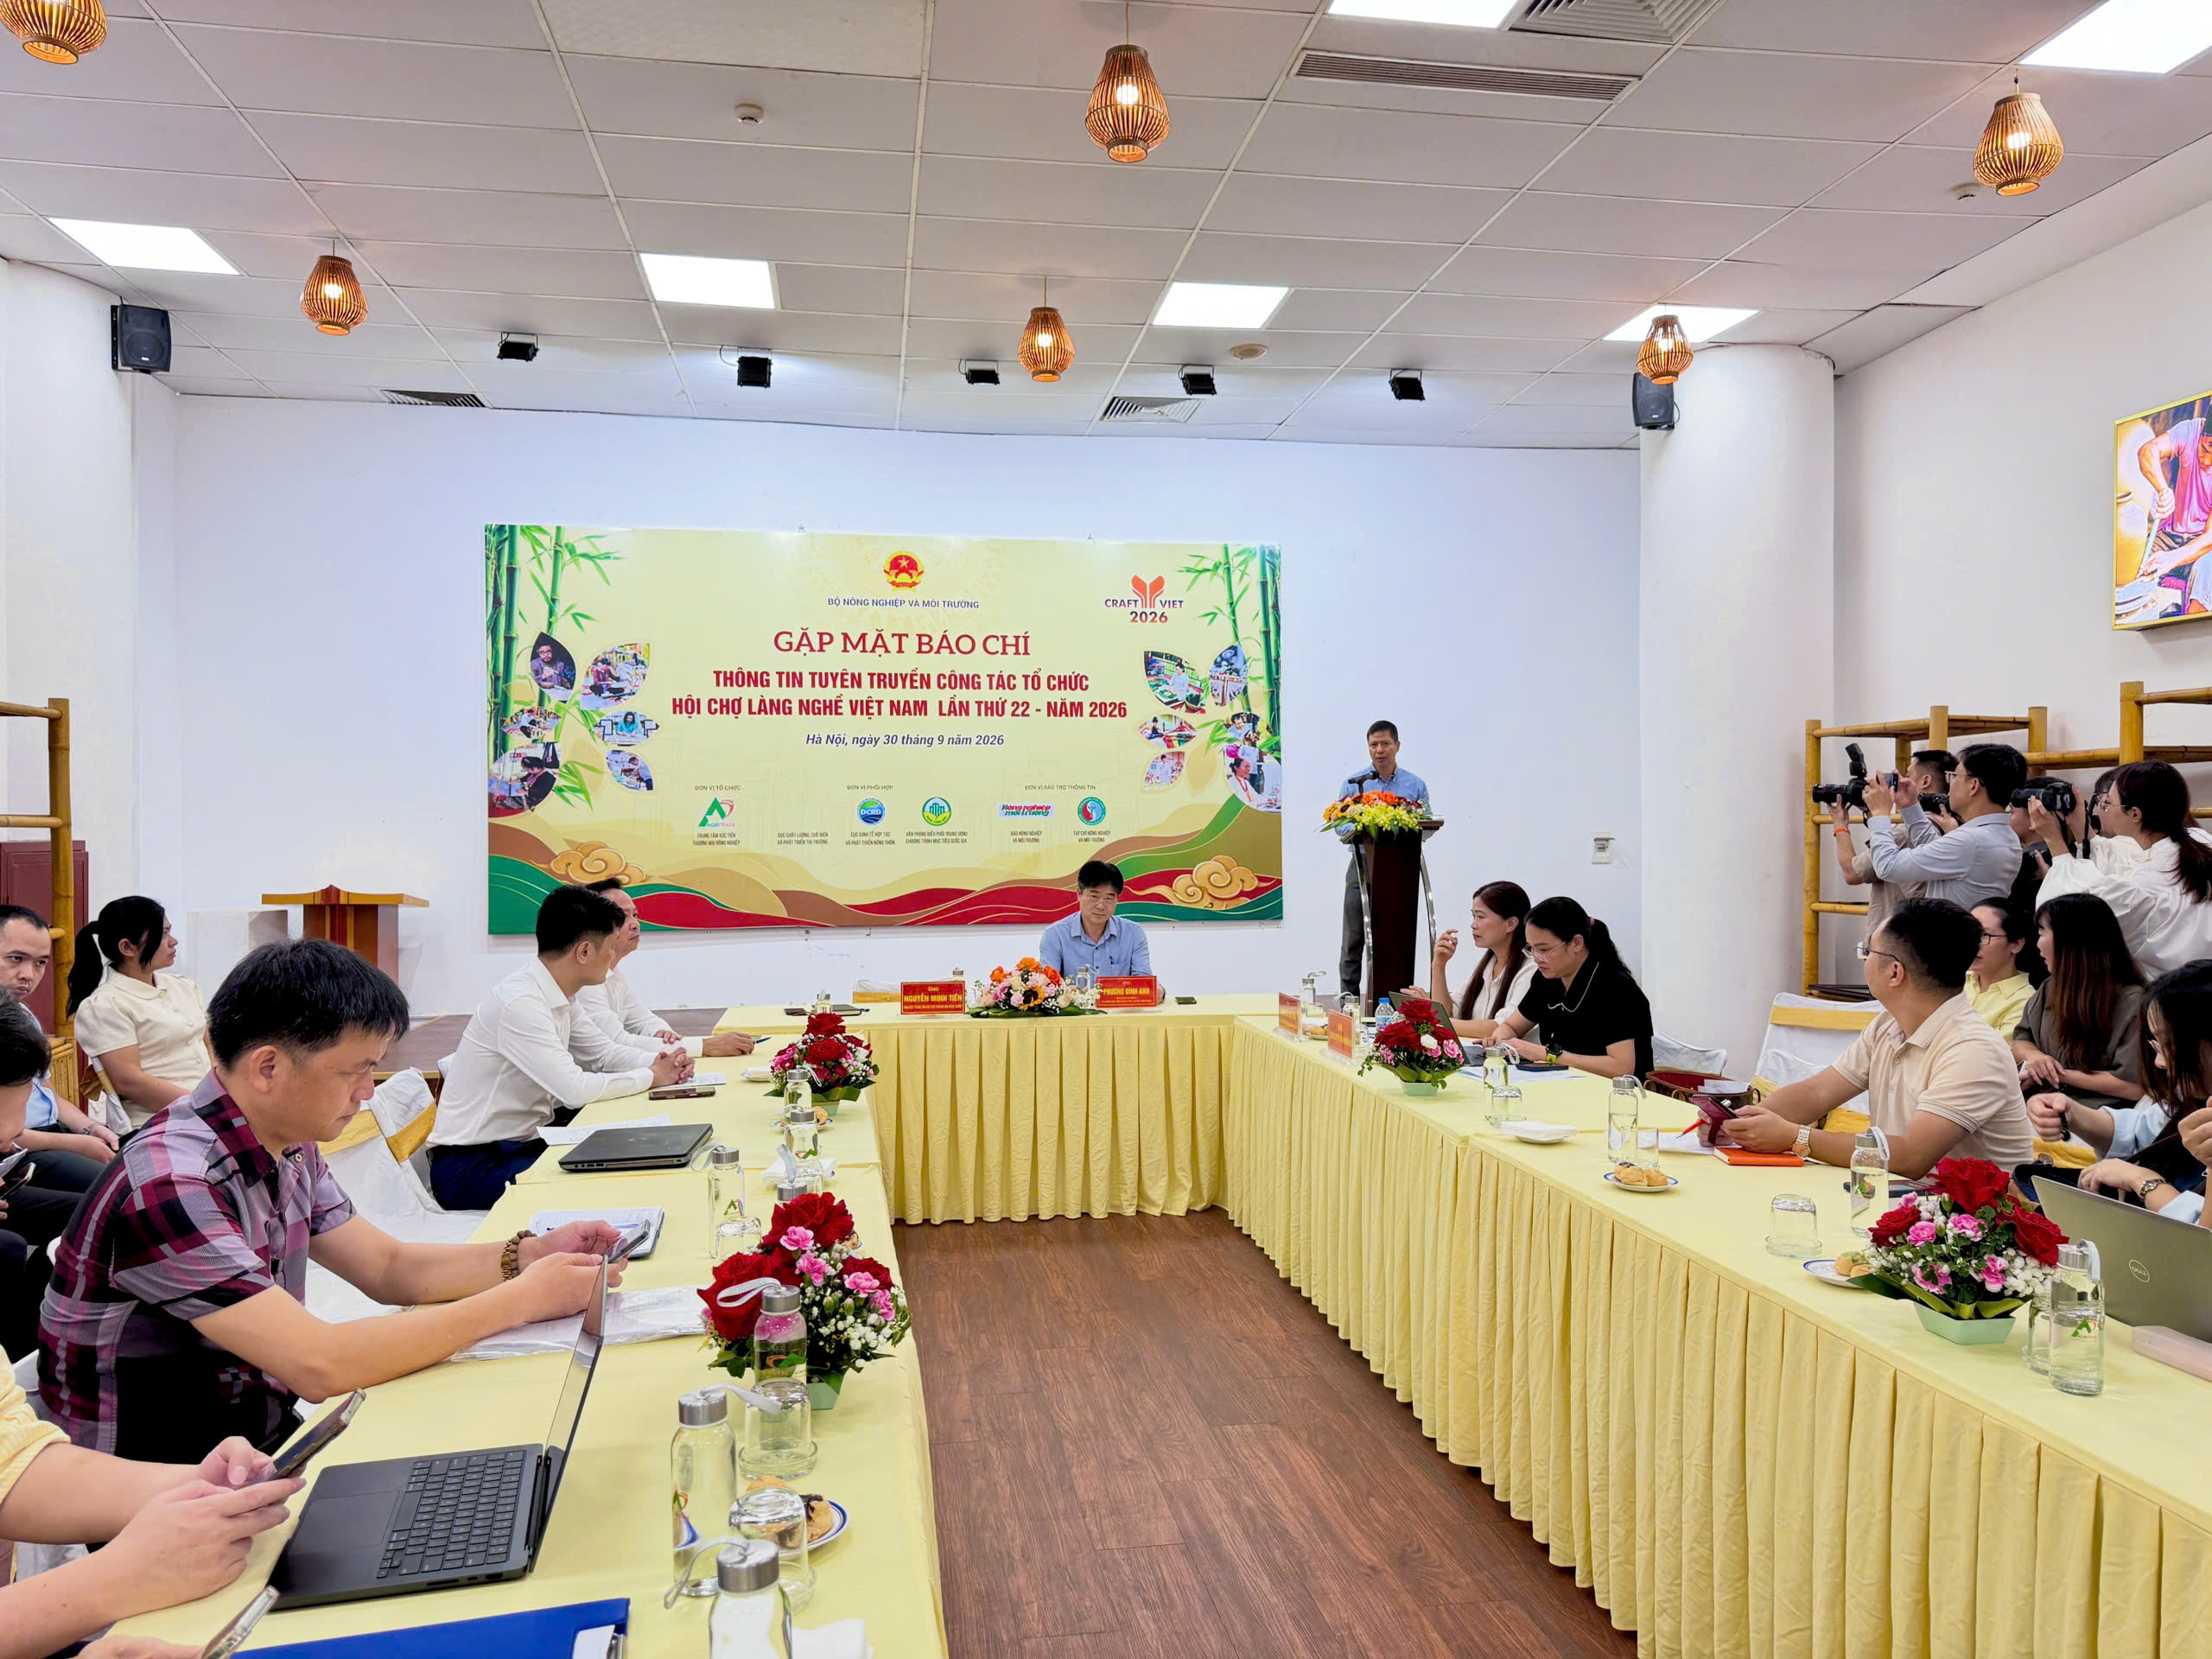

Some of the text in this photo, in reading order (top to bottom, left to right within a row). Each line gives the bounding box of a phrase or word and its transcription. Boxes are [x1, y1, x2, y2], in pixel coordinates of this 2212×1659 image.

[843, 597, 869, 607] NÔNG
[872, 597, 905, 608] NGHIỆP
[908, 597, 920, 607] VÀ
[922, 597, 939, 608] MÔI
[942, 598, 979, 609] TRƯỜNG
[1105, 599, 1139, 608] CRAFT
[1160, 600, 1184, 609] VIET
[1129, 611, 1168, 623] 2026
[773, 627, 1030, 658] GẶP MẶT BÁO CHÍ
[713, 667, 1089, 691] THÔNG TIN TUYÊN TRUYỀN CÔNG TÁC TỔ CHỨC
[672, 694, 701, 719] HỘI
[707, 696, 743, 719] CHỢ
[748, 695, 793, 716] LÀNG
[798, 693, 844, 716] NGHỀ
[849, 696, 884, 720] VIỆT
[889, 699, 928, 717] NAM
[938, 694, 970, 717] LẦN
[975, 698, 1007, 717] THỨ
[1011, 701, 1030, 718] 22
[1046, 697, 1084, 718] NĂM
[1089, 701, 1127, 718] 2026
[805, 734, 1004, 747] Hà Nội, ngày 30 tháng 9 năm 2026
